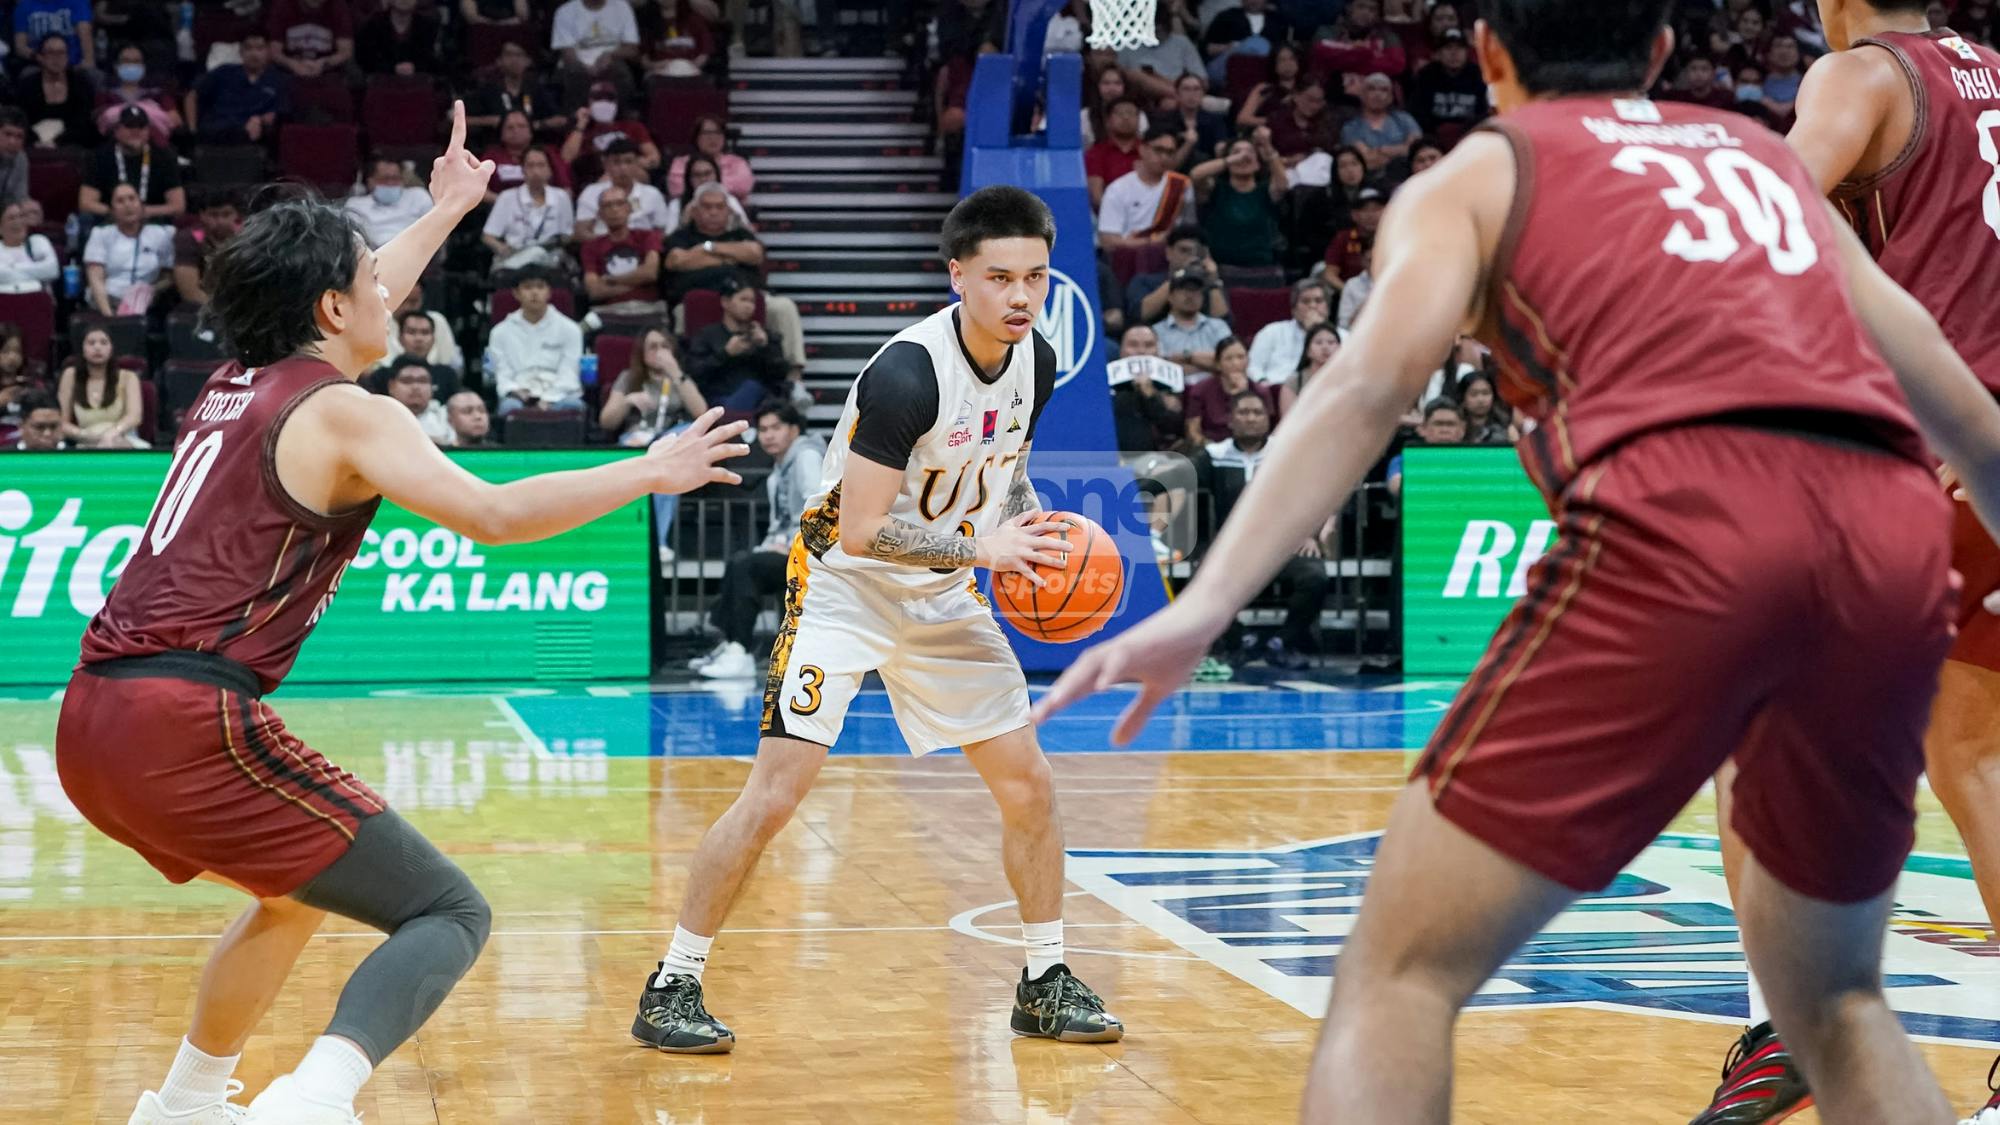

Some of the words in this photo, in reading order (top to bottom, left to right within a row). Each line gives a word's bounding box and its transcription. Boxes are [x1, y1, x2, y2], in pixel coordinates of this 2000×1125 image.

[1950, 66, 2000, 101] BAYL
[1610, 146, 1819, 275] 30
[193, 390, 256, 422] PORTER
[135, 430, 224, 557] 10
[350, 527, 486, 569] COOL
[381, 572, 456, 612] KA
[466, 570, 609, 612] LANG
[789, 664, 825, 717] 3
